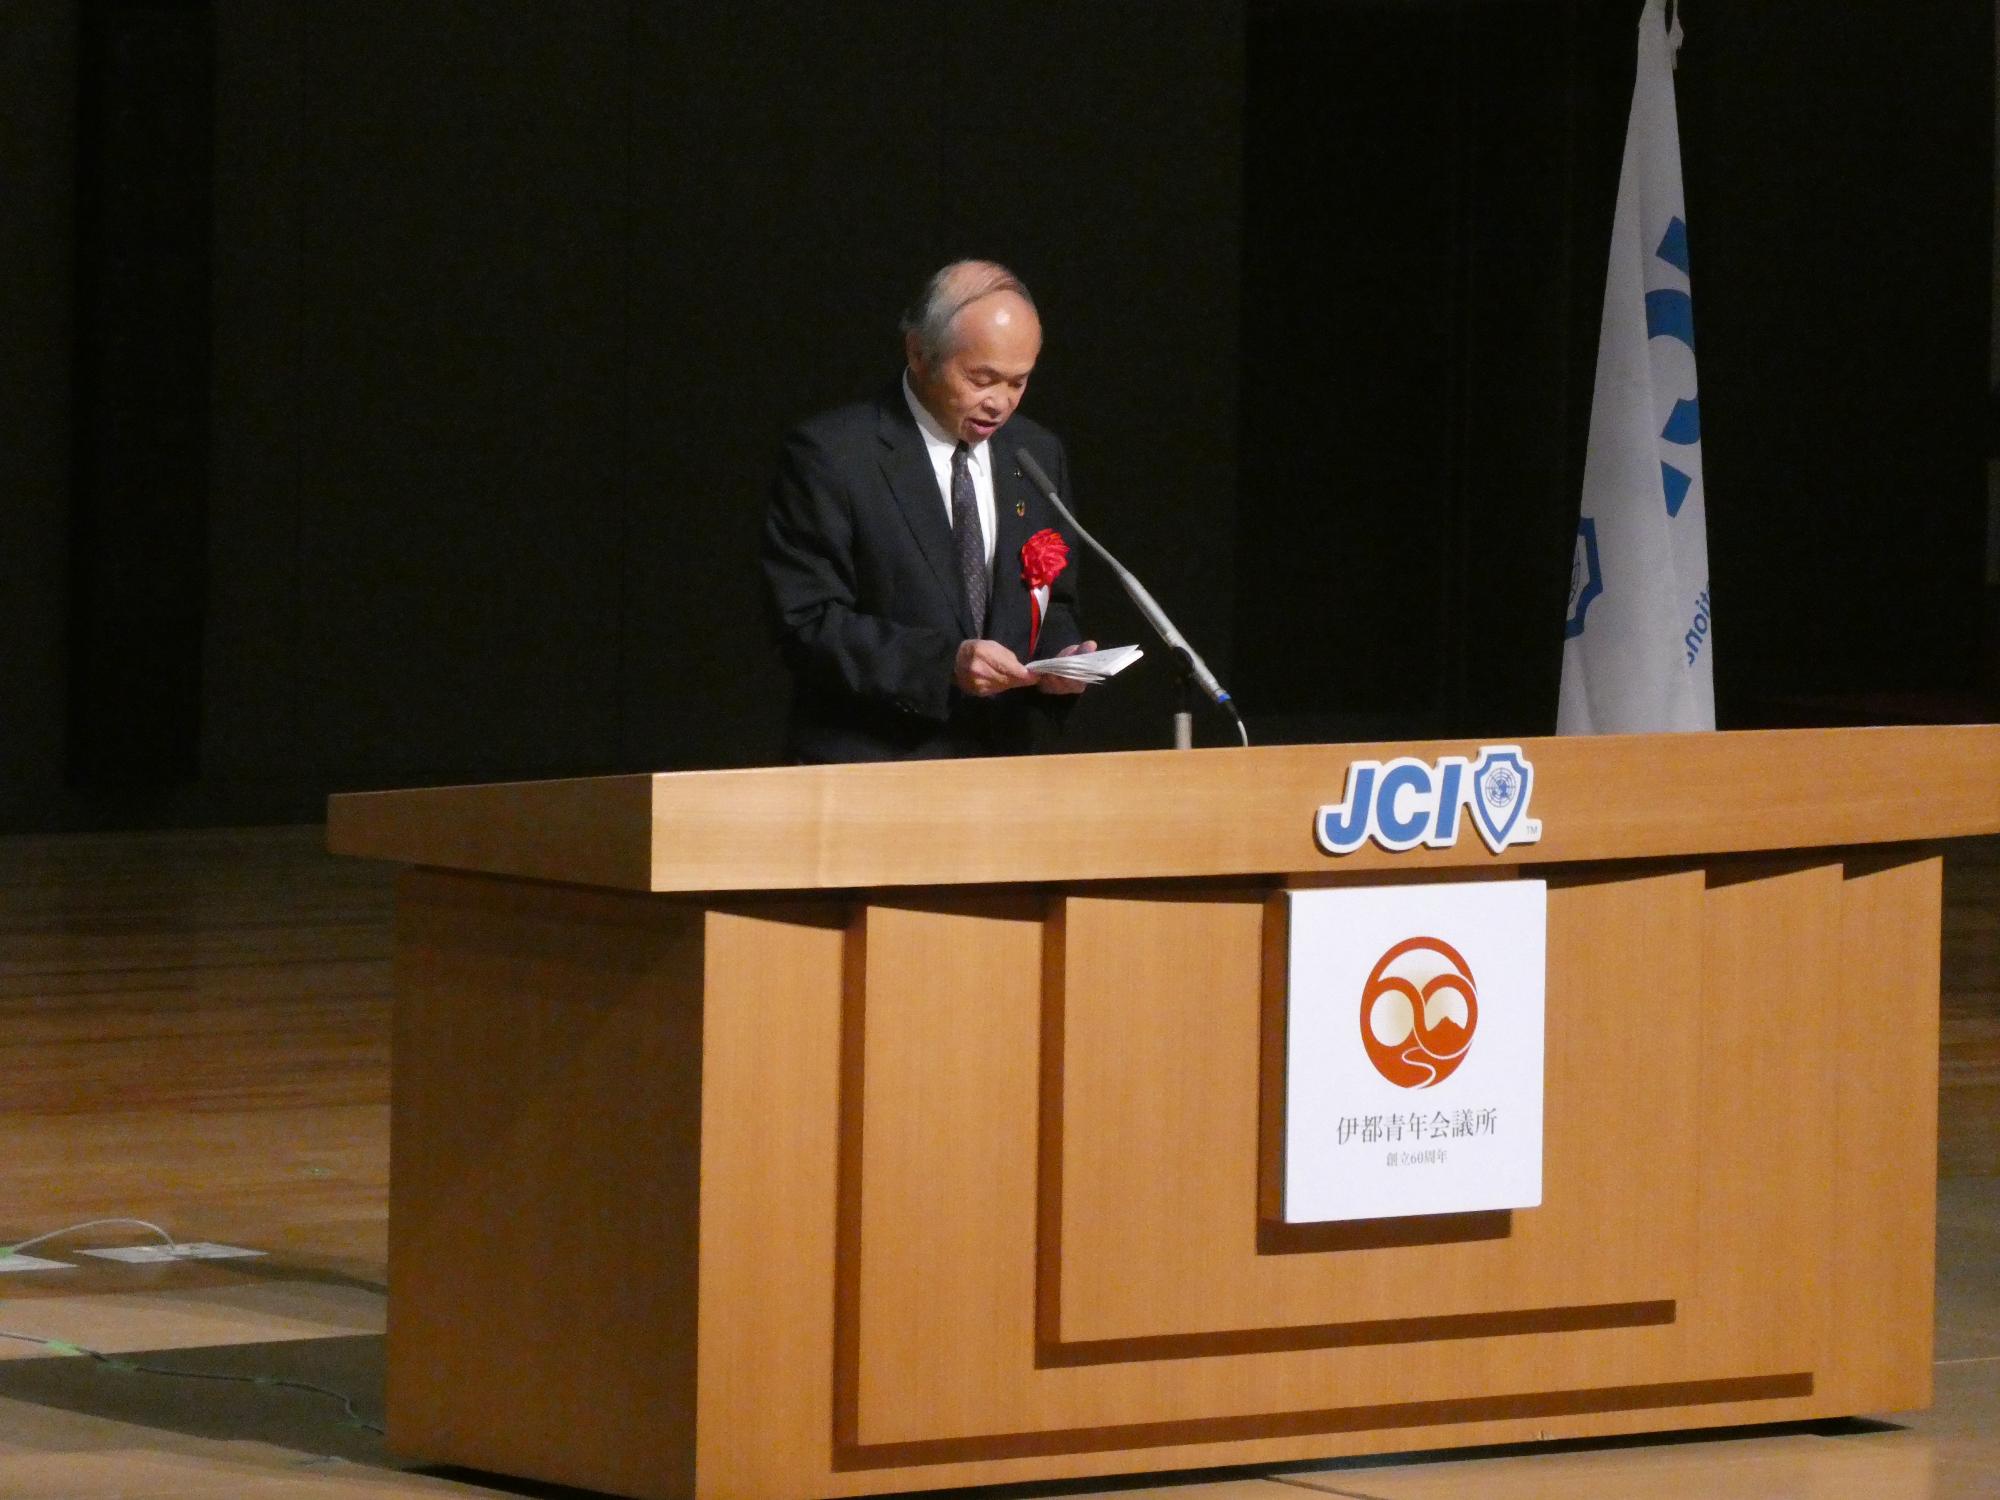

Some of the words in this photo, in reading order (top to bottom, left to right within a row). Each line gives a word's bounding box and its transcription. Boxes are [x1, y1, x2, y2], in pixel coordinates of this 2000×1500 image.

[1325, 763, 1463, 846] JCI
[1336, 1107, 1498, 1146] 伊都青年会議所
